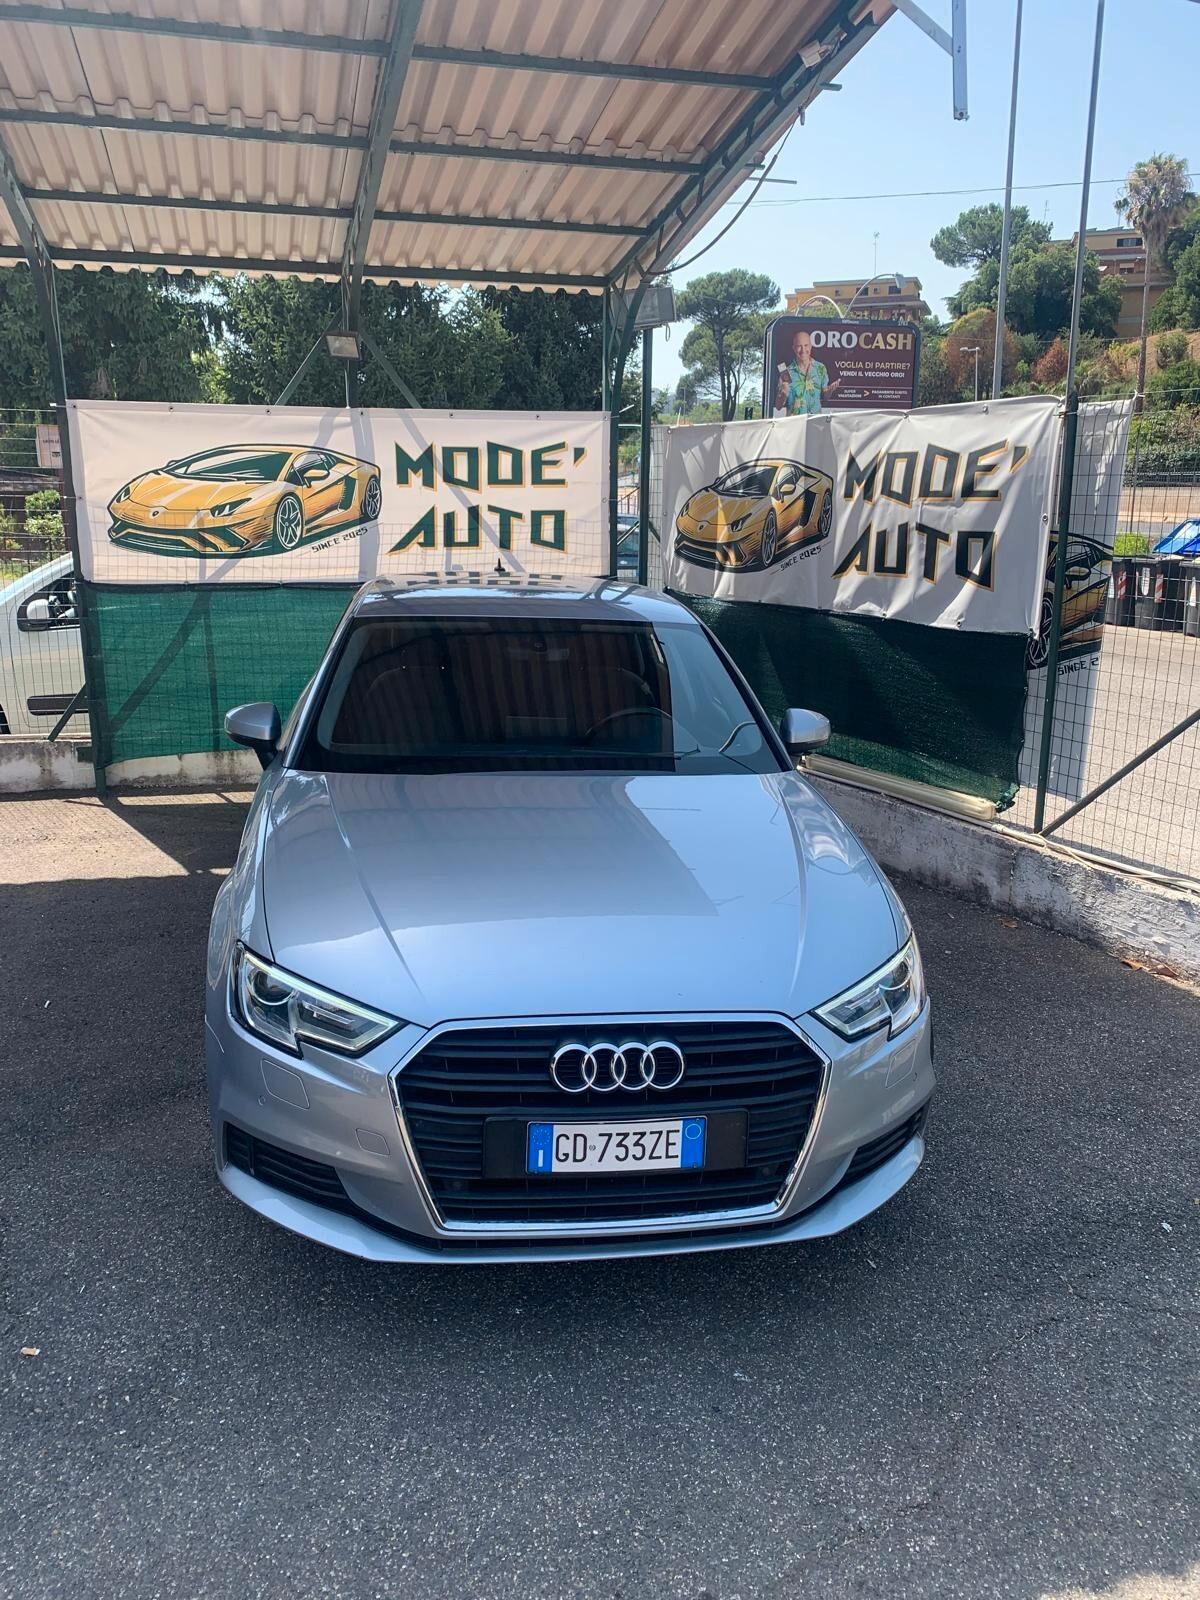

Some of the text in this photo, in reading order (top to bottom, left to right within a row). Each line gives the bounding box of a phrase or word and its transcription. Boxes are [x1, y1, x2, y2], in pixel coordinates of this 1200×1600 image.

[835, 361, 911, 370] VOGLIA DI PARTIRE?
[311, 527, 368, 553] SINCE 2025
[386, 503, 568, 555] AUTO
[780, 545, 822, 572] SINCE 2025
[831, 520, 998, 592] AUTO
[1057, 656, 1100, 676] SINCE 2
